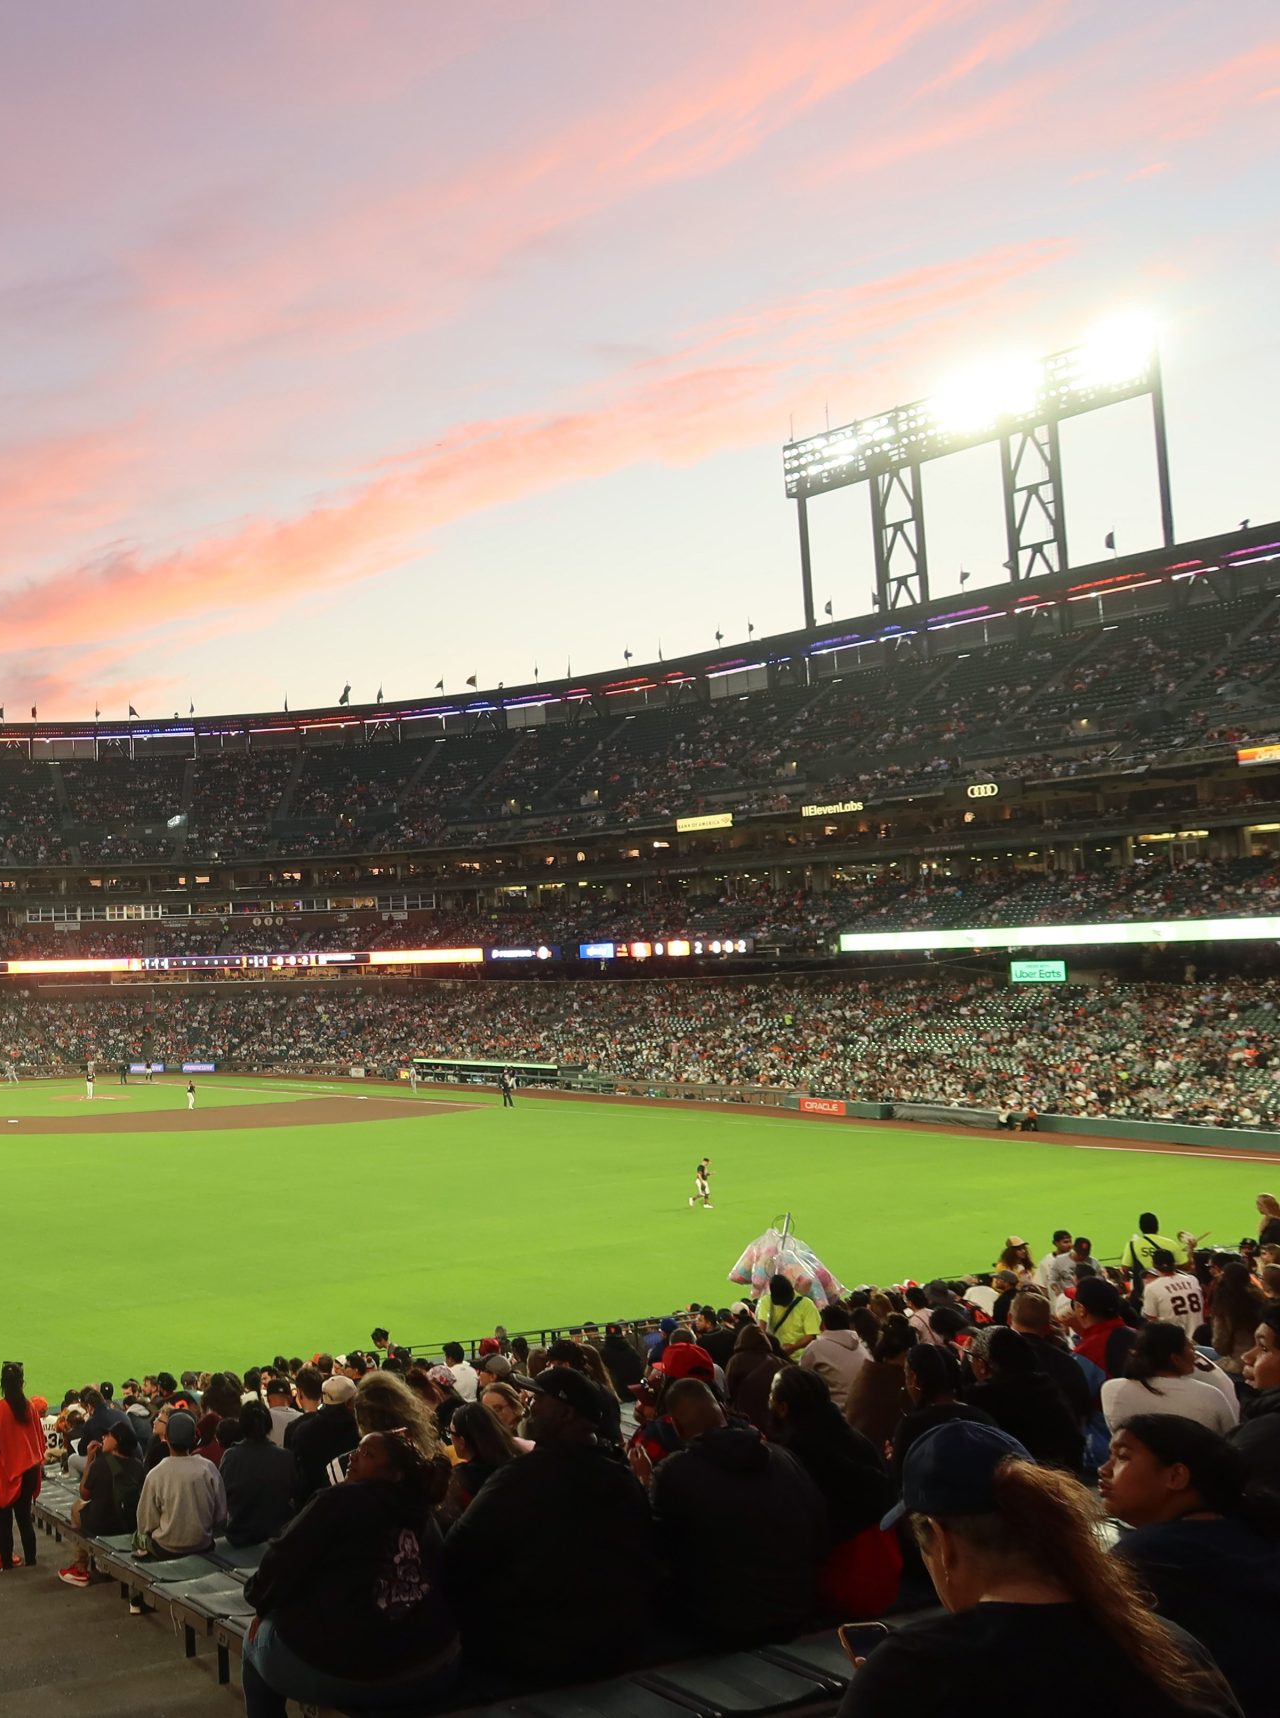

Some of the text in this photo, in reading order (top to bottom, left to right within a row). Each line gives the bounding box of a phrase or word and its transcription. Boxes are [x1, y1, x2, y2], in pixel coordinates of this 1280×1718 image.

[1039, 969, 1062, 978] Eats
[804, 1101, 839, 1111] ORACLE
[1164, 1281, 1192, 1293] POSEY
[1170, 1293, 1202, 1316] 28
